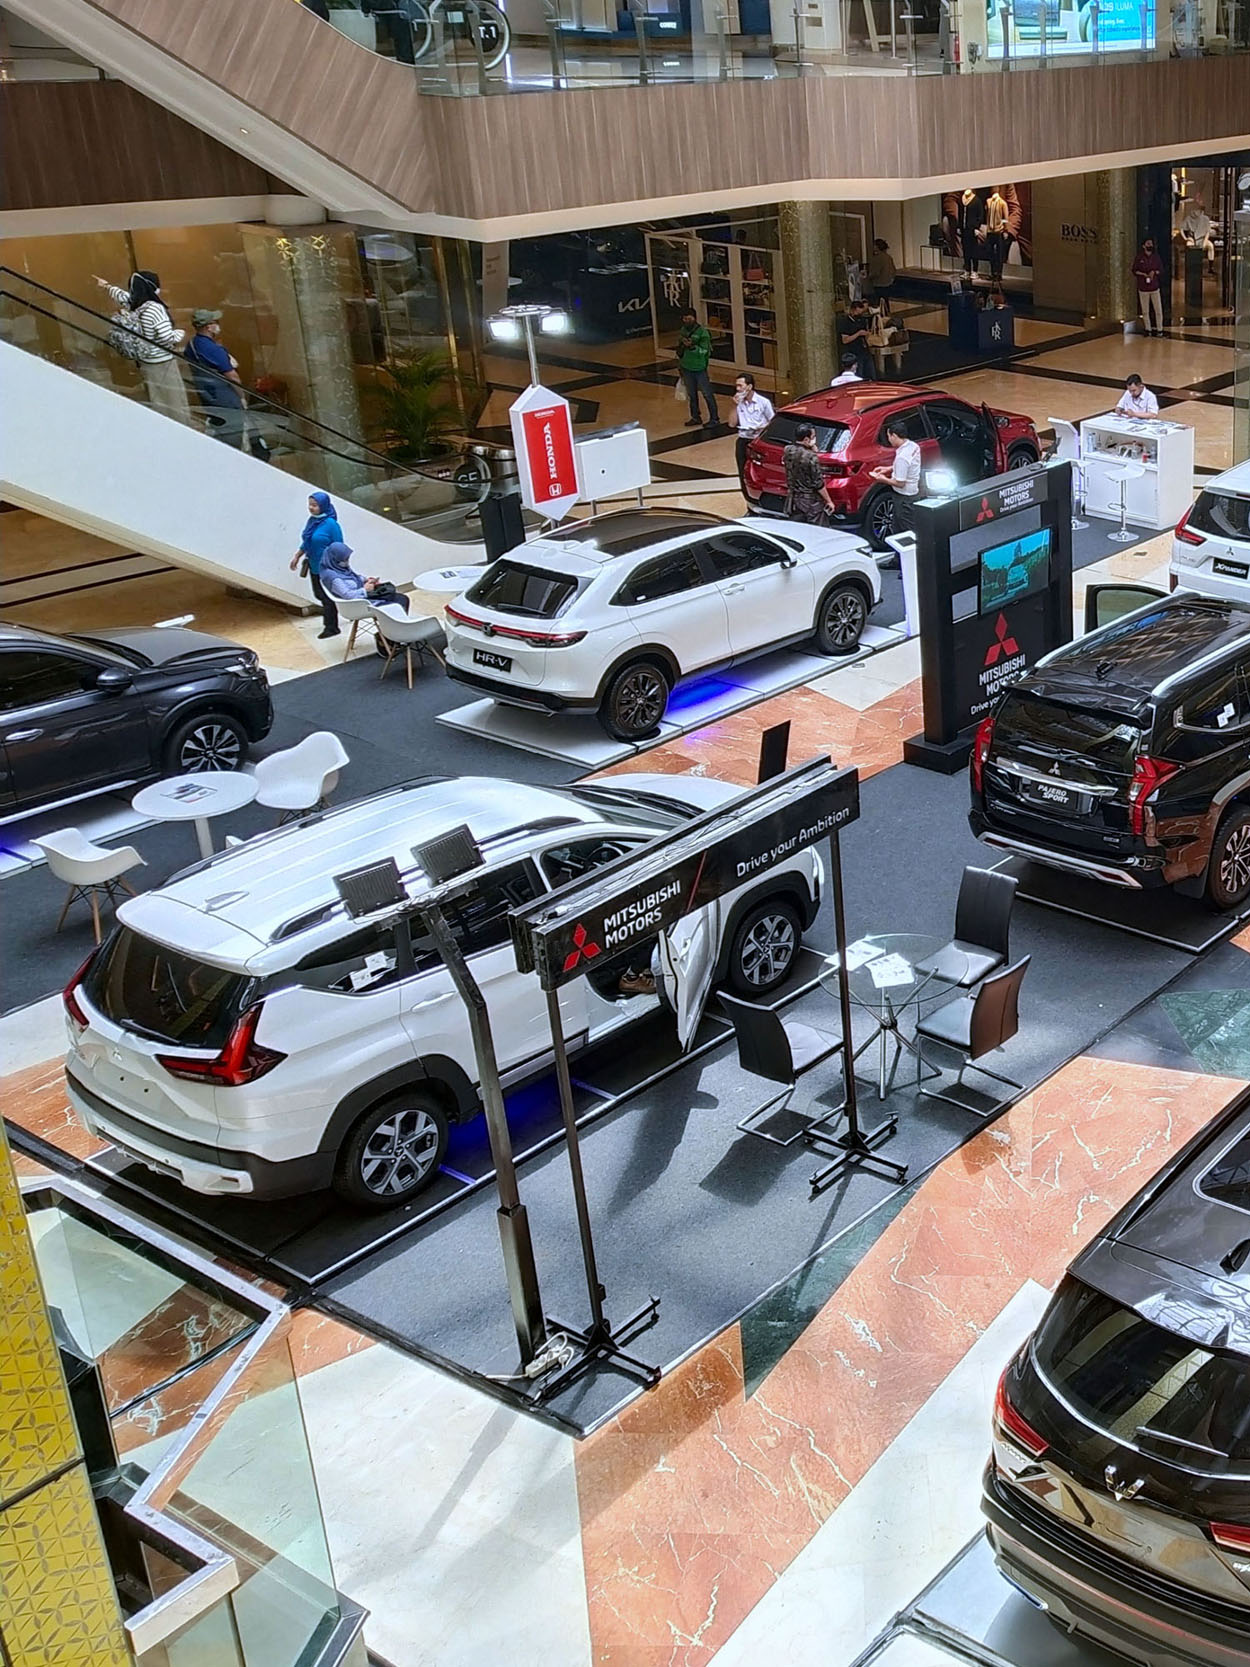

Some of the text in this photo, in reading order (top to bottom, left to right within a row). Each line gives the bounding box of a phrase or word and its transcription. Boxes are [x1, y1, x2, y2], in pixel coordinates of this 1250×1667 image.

[1061, 223, 1097, 239] BOSS
[543, 421, 558, 480] HONDA
[999, 480, 1034, 498] MITSUBISHI
[1004, 490, 1030, 506] MOTORS
[475, 651, 508, 667] HR-V
[979, 654, 1026, 686] MITSUBISHI
[971, 702, 989, 715] Drive
[1037, 784, 1067, 797] PAJERO
[1042, 791, 1069, 804] SPORT
[735, 806, 850, 878] Drive your Ambition
[603, 879, 681, 933] MITSUBISHI
[605, 907, 663, 950] MOTORS
